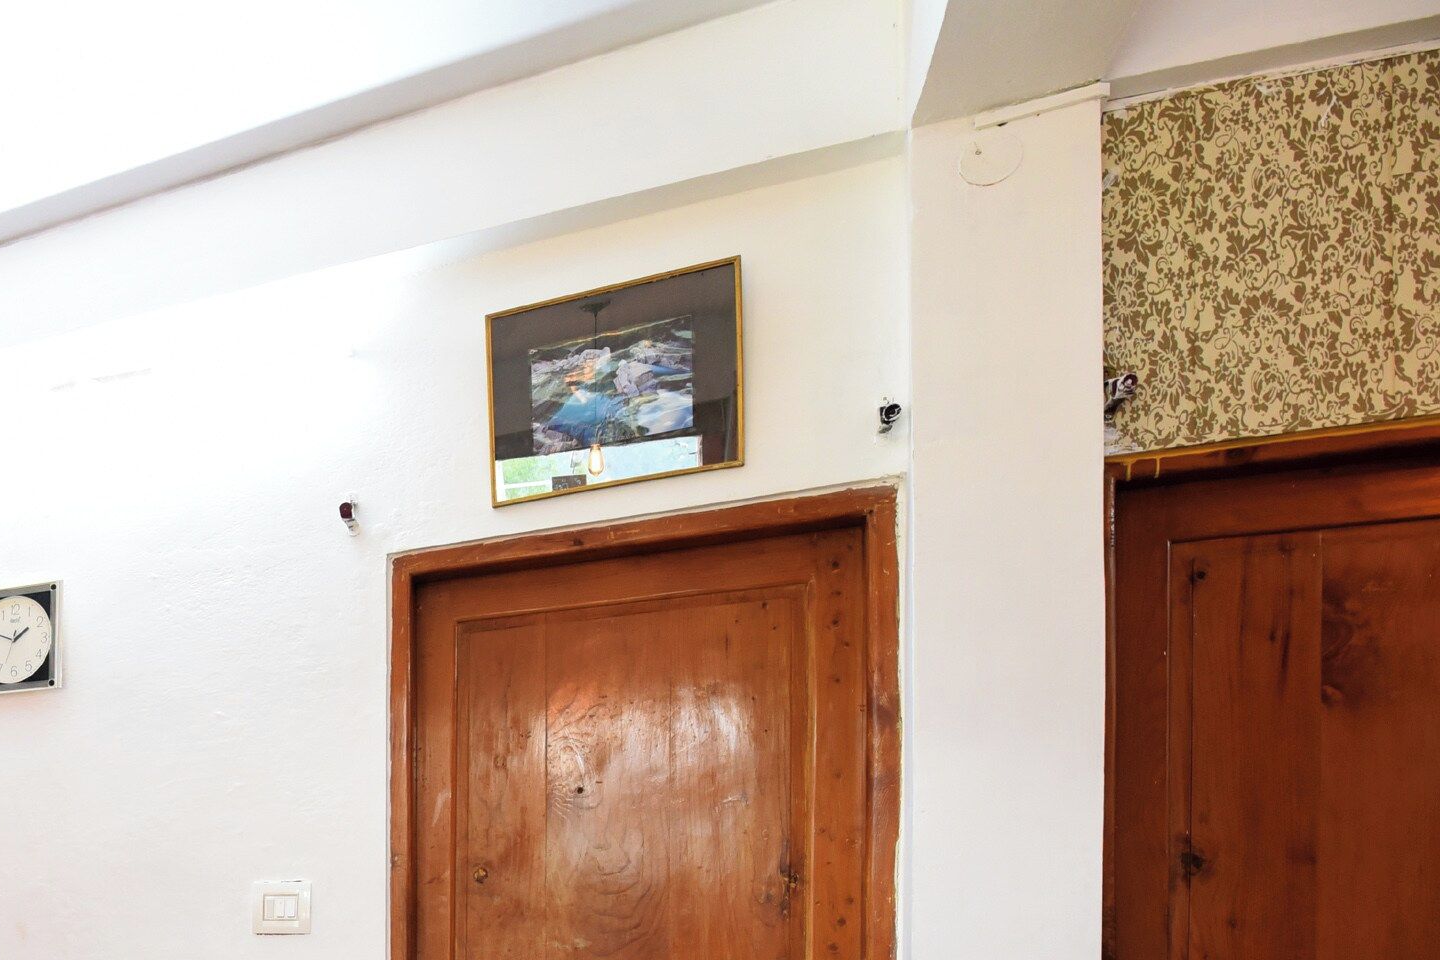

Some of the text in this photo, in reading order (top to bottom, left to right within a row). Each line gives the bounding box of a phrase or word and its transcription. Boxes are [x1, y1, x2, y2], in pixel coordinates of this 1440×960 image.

[11, 603, 21, 616] 12
[36, 616, 44, 628] 2
[41, 631, 48, 644] 3
[35, 648, 42, 659] 4
[10, 666, 18, 677] 6
[25, 660, 32, 672] 5
